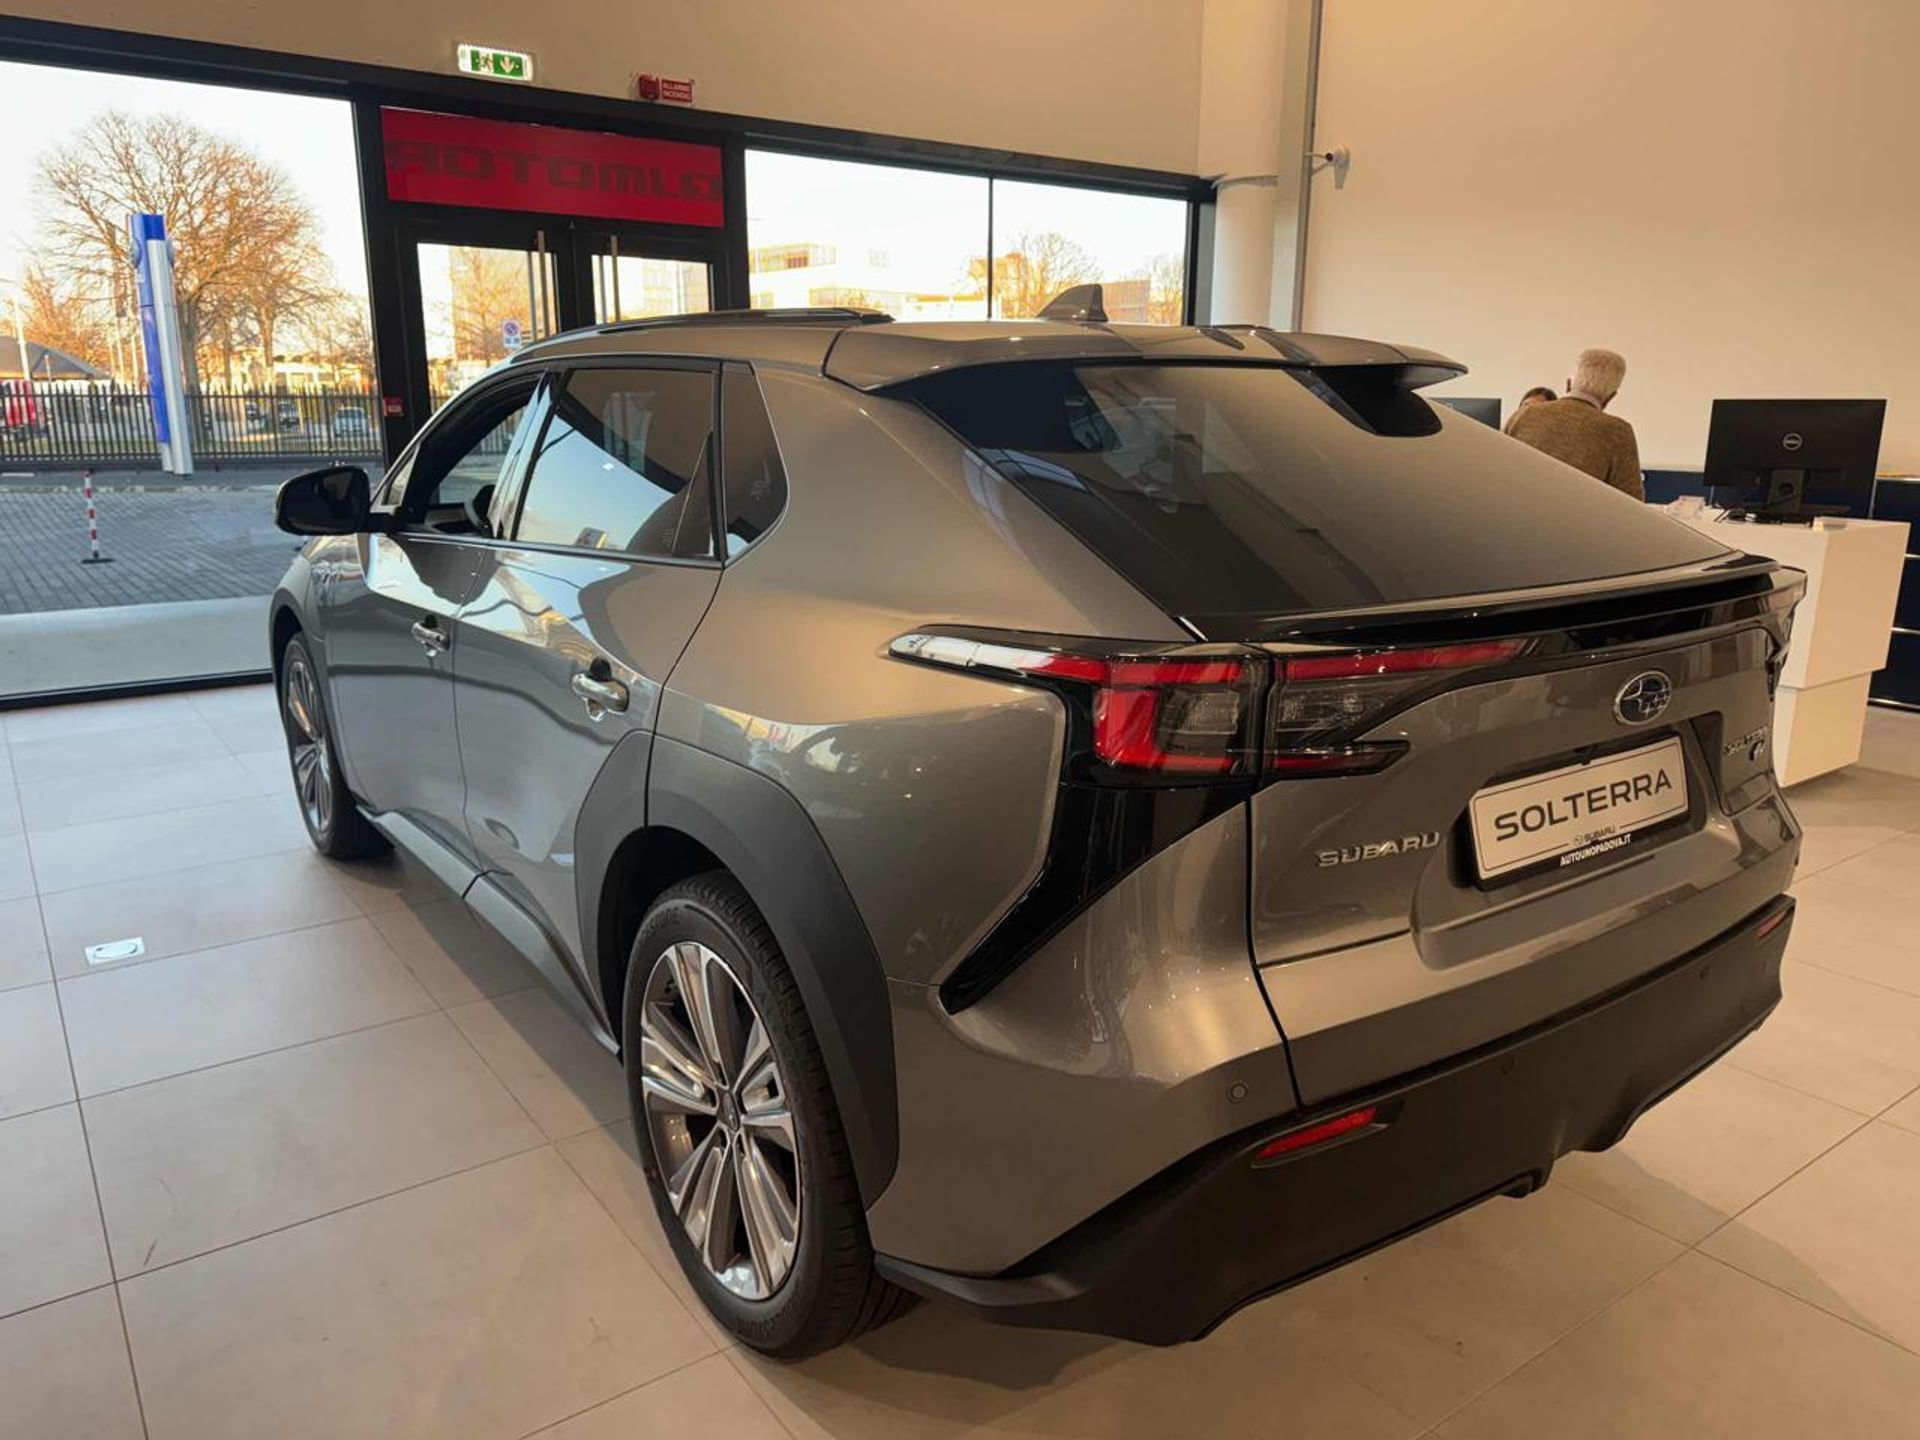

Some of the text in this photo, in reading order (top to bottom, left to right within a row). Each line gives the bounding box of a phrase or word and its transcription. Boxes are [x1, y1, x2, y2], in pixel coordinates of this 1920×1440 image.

[1494, 768, 1672, 841] SOLTERRA
[1318, 831, 1440, 867] SUBARU
[1584, 826, 1616, 841] SUBARU
